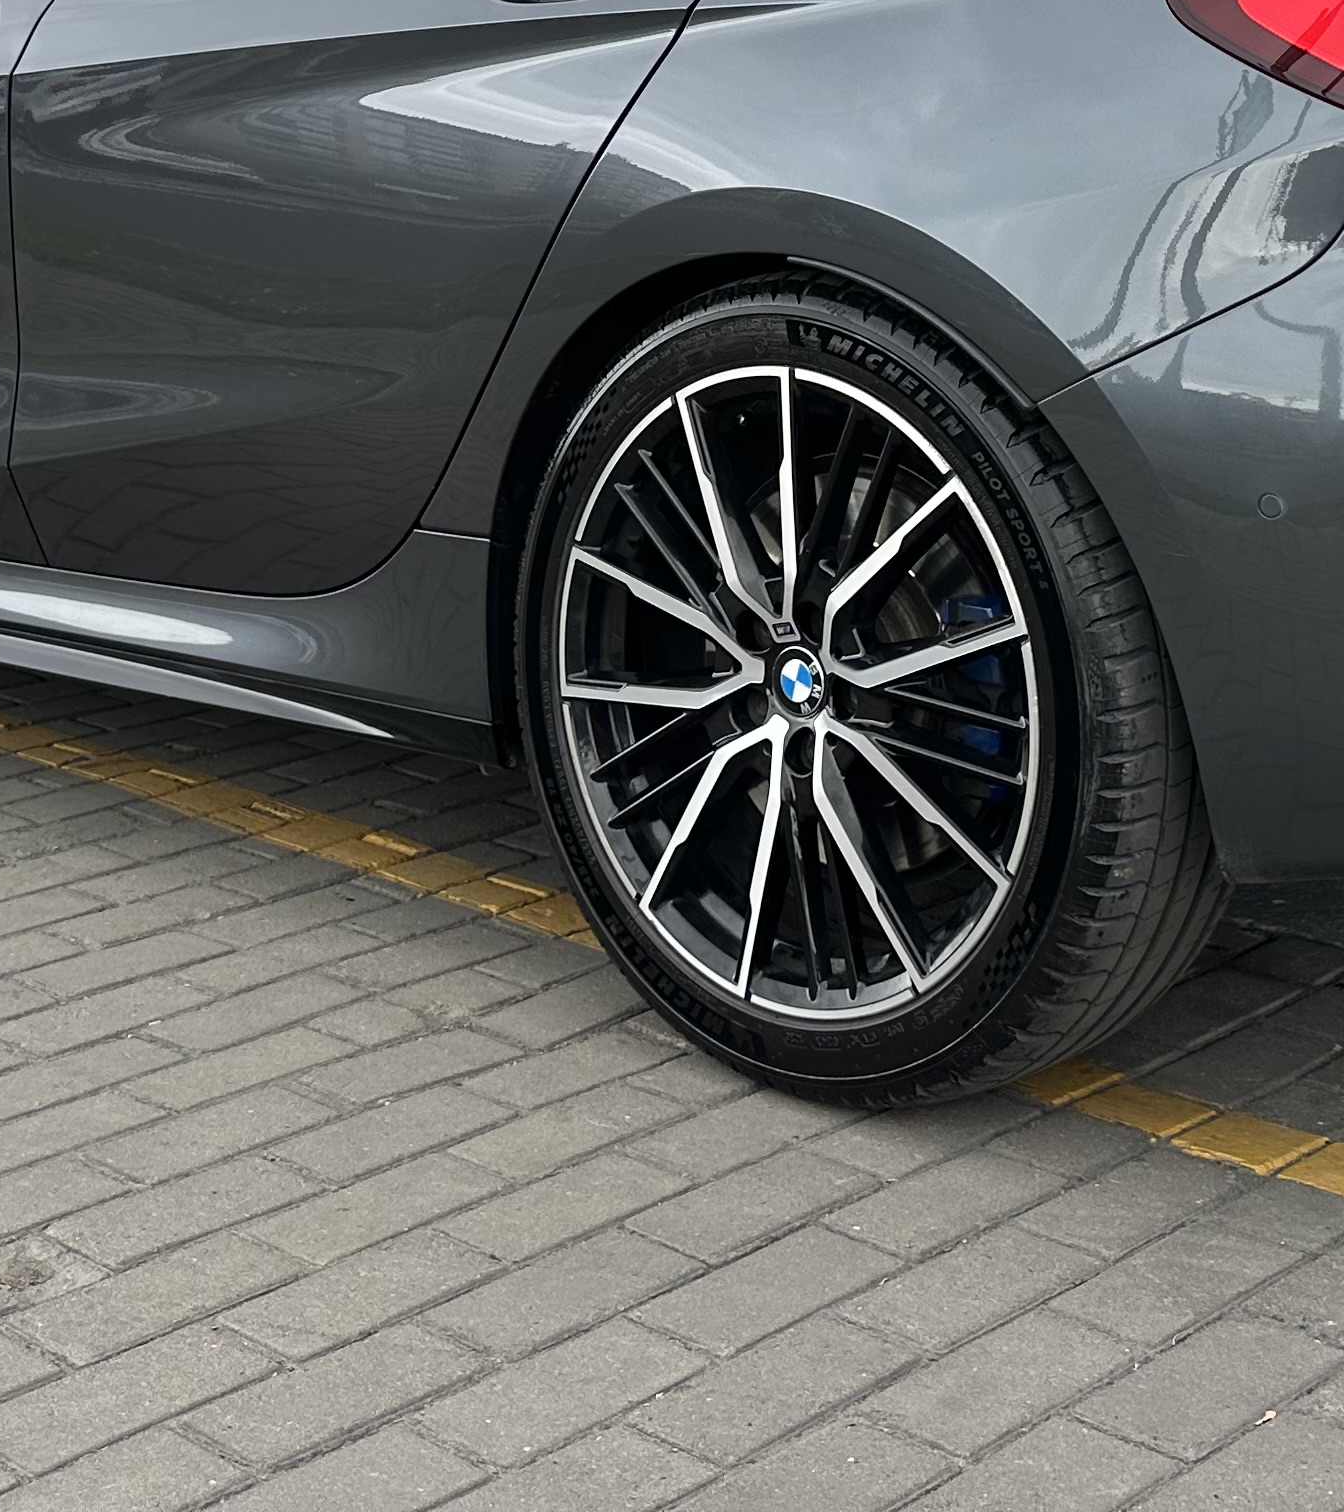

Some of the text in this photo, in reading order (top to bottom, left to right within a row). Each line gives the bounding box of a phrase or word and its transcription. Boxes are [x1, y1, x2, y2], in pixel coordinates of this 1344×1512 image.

[826, 334, 965, 437] MICHELIN
[971, 451, 1013, 501] PILOT
[1006, 507, 1044, 575] SPORT
